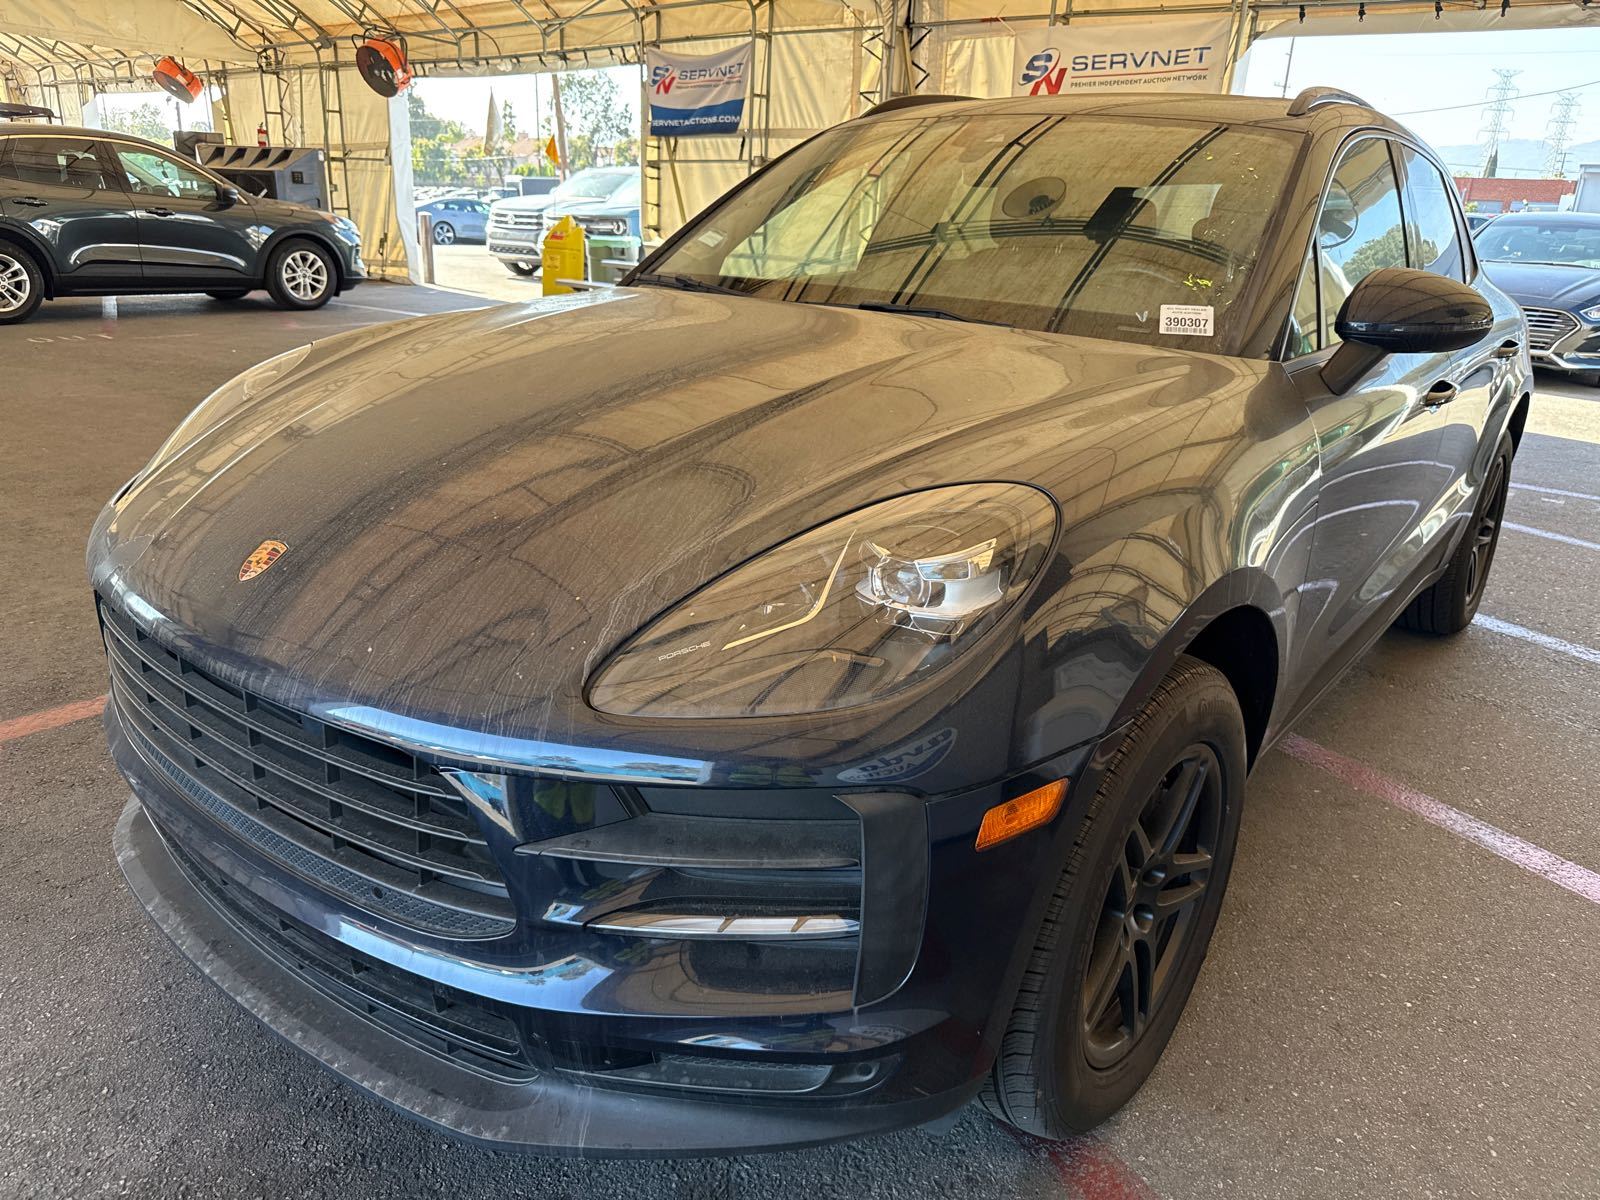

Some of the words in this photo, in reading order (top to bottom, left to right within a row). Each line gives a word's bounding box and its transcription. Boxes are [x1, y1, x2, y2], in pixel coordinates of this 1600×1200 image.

[1071, 47, 1211, 71] SERVNET
[678, 63, 744, 80] SERVNET
[1097, 78, 1143, 87] INDEPENDENT
[1142, 76, 1172, 84] AUCTION
[1165, 316, 1209, 328] 390307
[658, 640, 711, 661] PORSCHE
